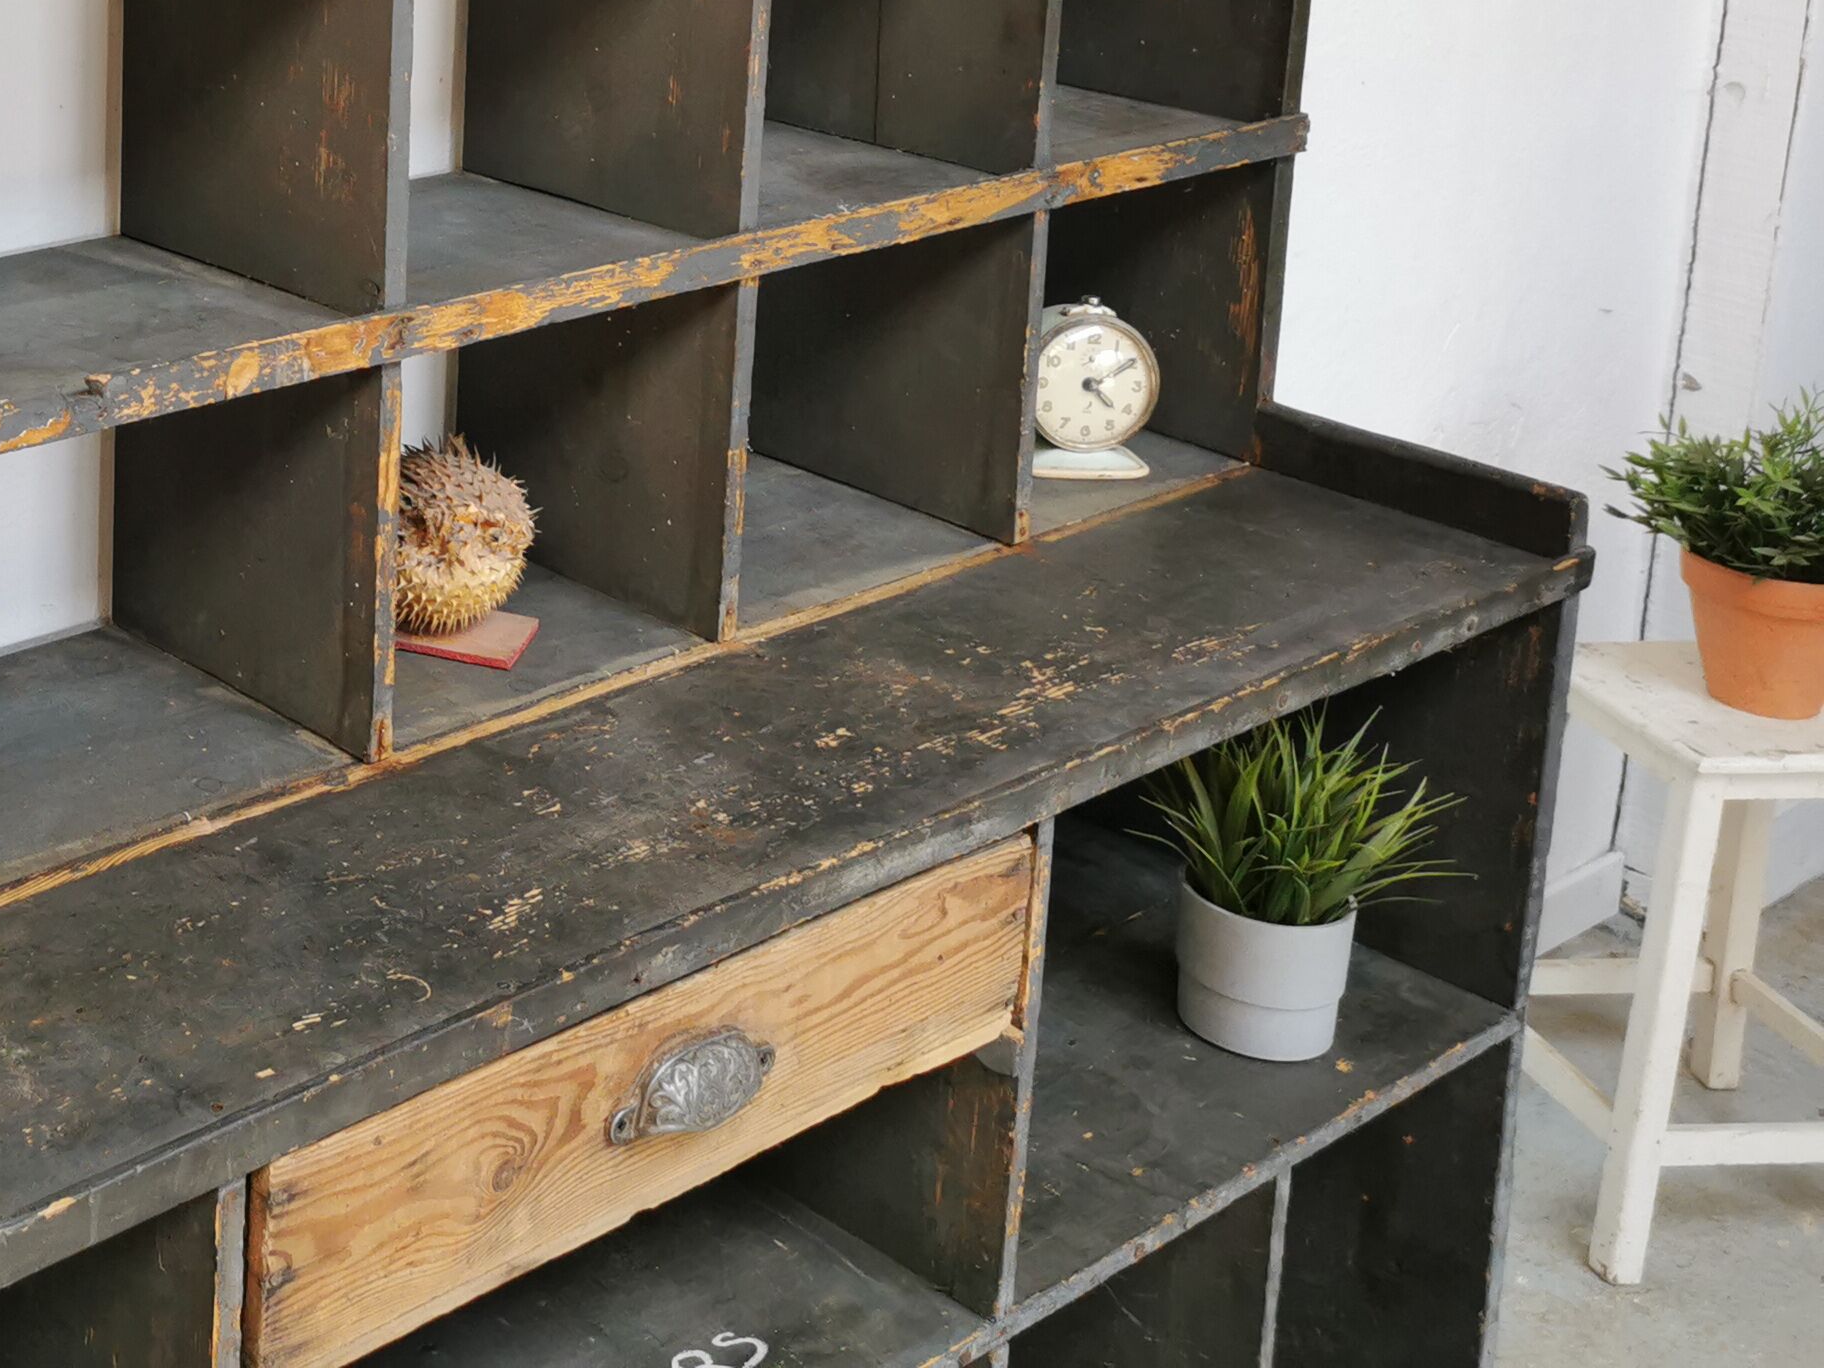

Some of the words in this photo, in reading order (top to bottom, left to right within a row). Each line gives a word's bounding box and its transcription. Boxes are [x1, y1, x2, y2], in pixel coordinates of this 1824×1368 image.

[1132, 381, 1142, 393] 3
[1041, 400, 1052, 413] 8
[1060, 417, 1071, 429] 7
[1104, 419, 1115, 431] 5
[1080, 425, 1091, 437] 6
